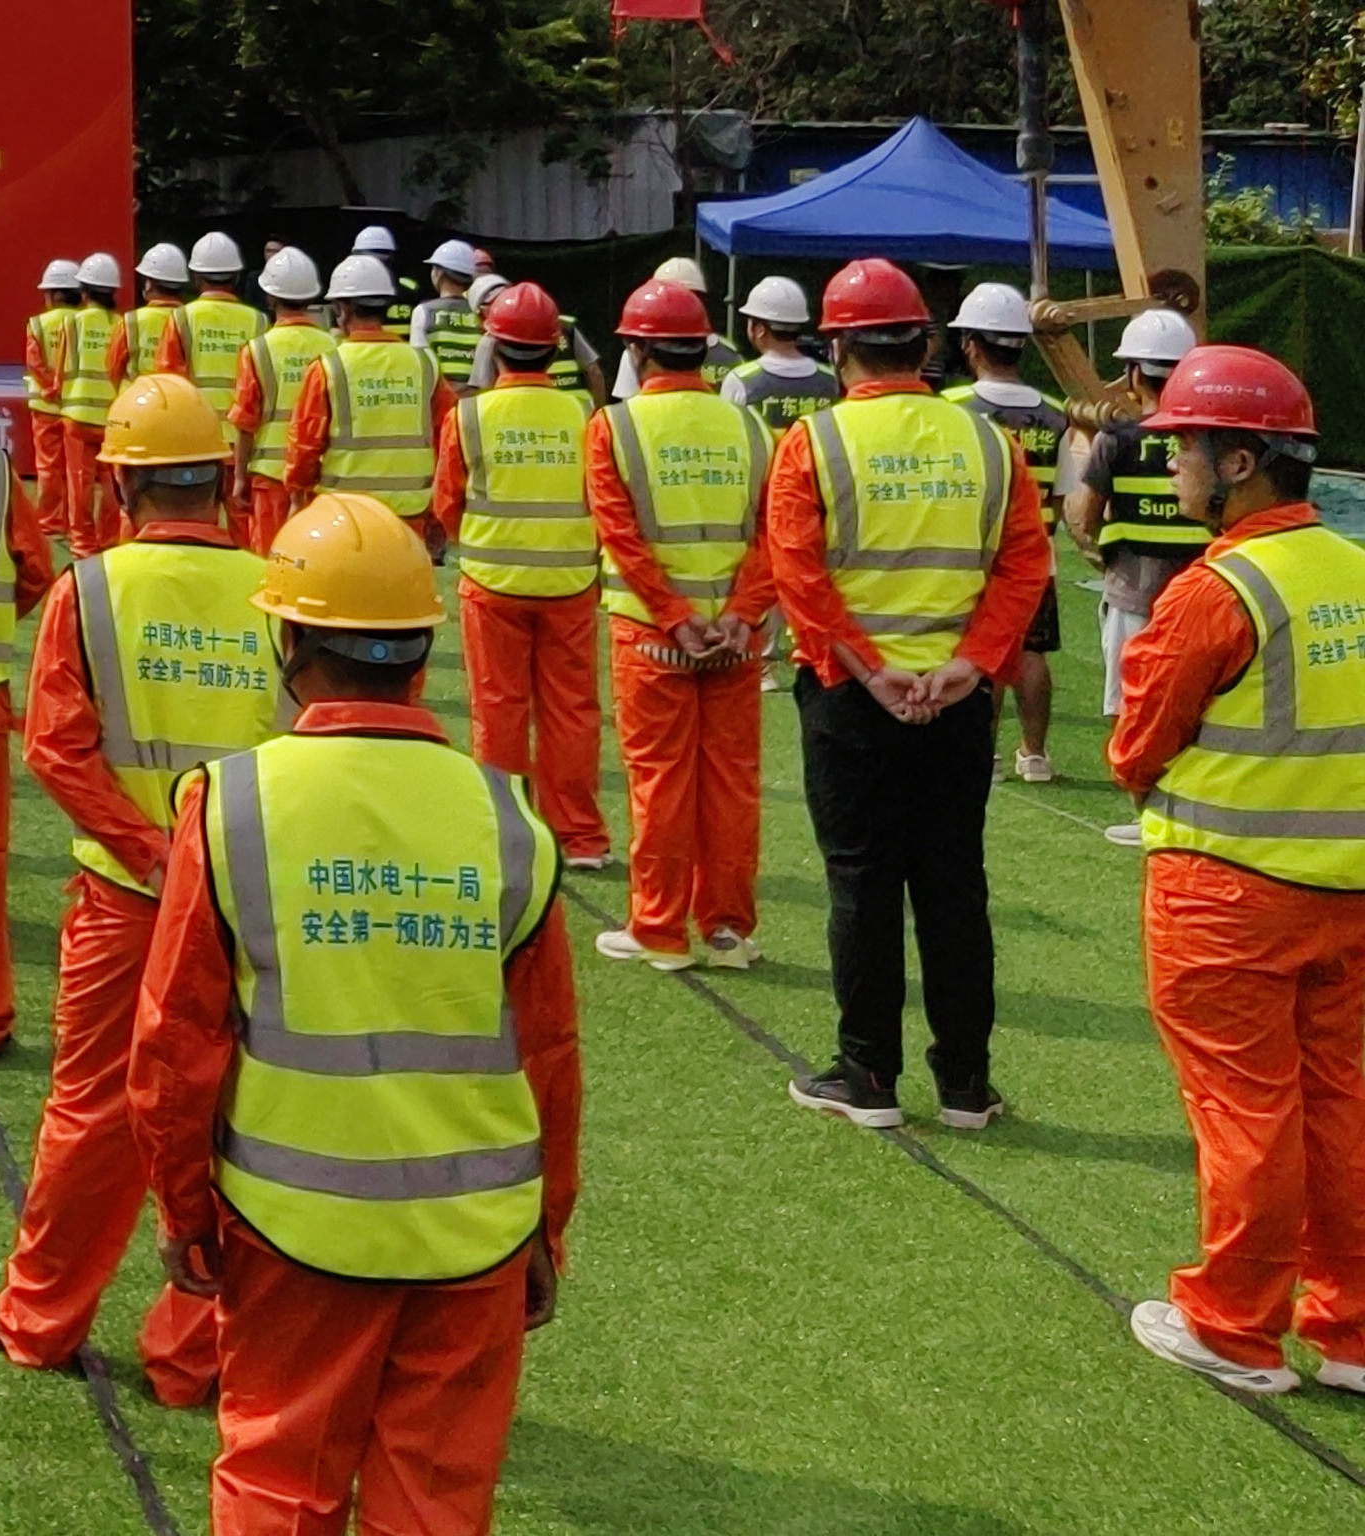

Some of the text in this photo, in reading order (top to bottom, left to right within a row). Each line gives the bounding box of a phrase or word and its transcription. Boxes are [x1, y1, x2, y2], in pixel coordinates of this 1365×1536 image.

[867, 452, 967, 476] 中国水电十一局
[866, 479, 978, 502] 安全第一预防为主
[142, 620, 259, 657] 中国水电十一局
[136, 657, 268, 692] 安全第一预防为主
[306, 858, 481, 903] 中国水电十一局
[301, 908, 497, 952] 安全第一预防为主
